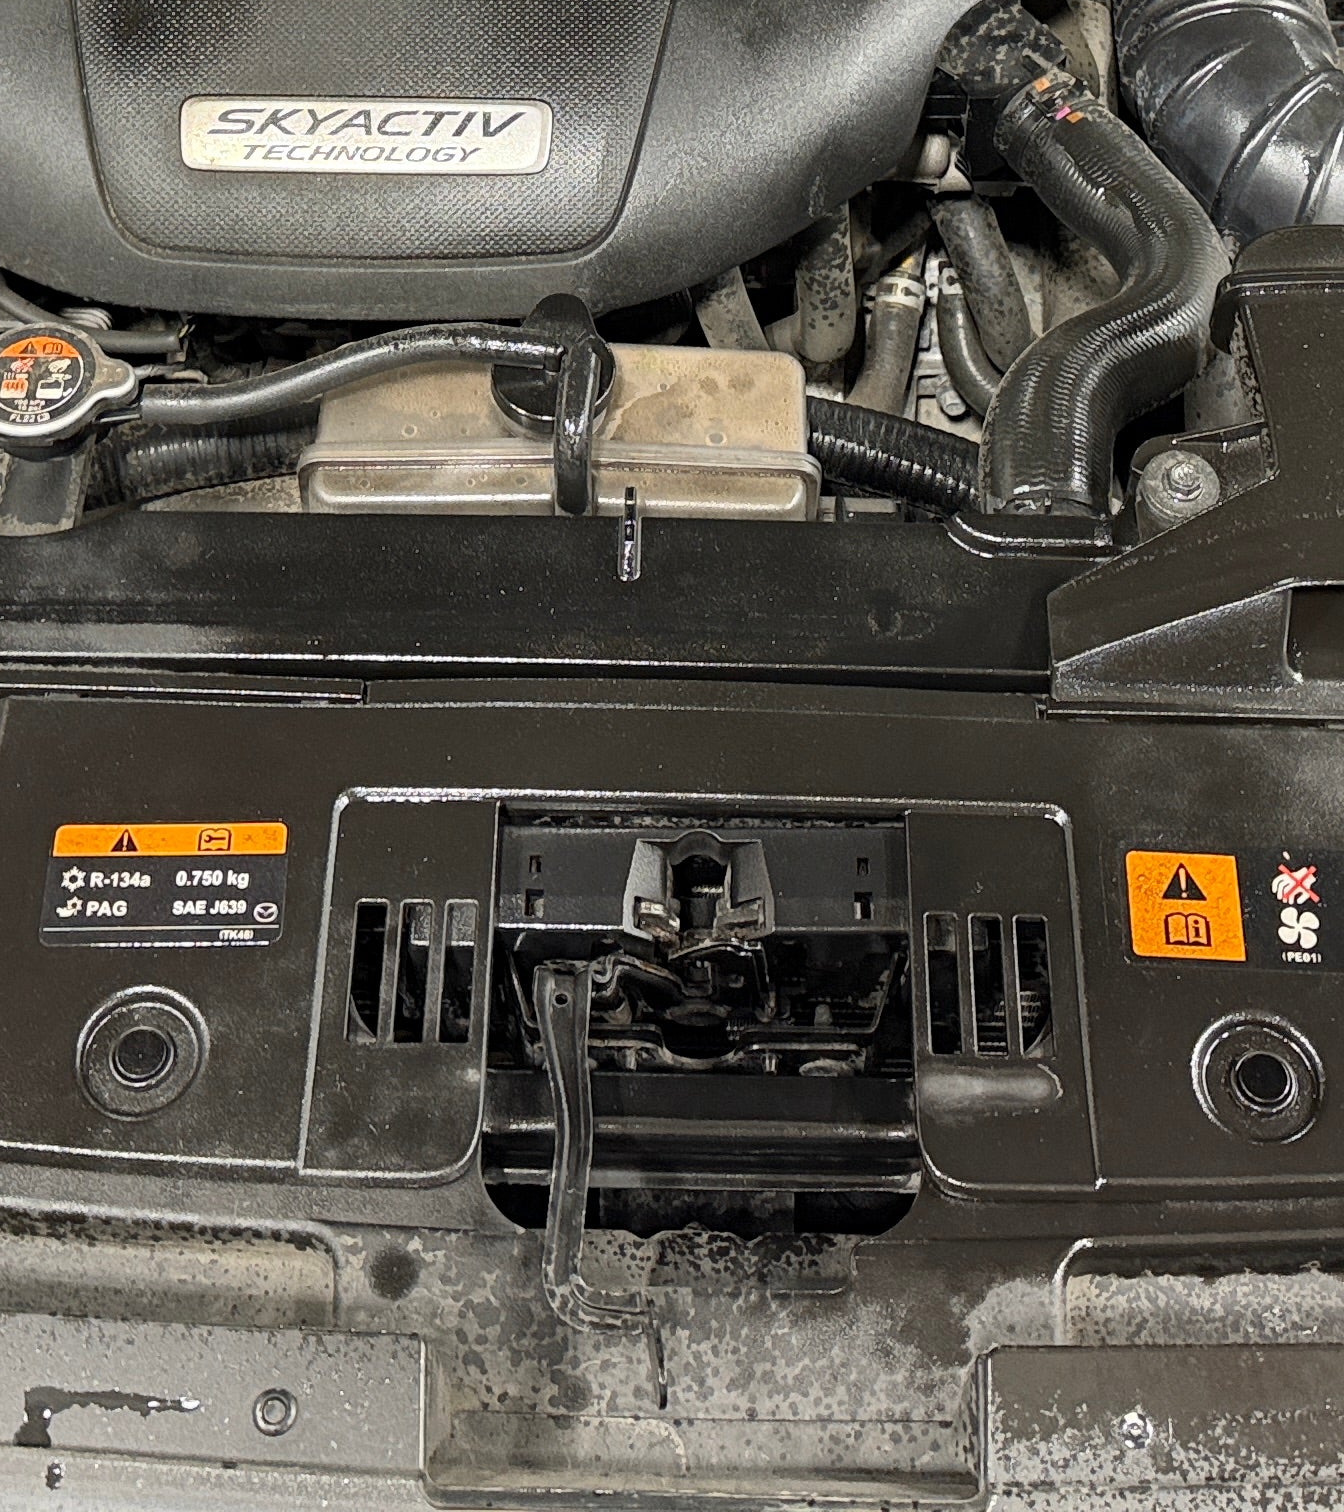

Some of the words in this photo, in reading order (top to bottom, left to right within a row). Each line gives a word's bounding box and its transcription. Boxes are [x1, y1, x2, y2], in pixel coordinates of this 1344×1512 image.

[207, 108, 528, 138] SKYACTIV
[242, 144, 483, 165] TECHNOLOGY
[9, 413, 35, 423] FL22
[90, 871, 151, 888] R-134a
[175, 870, 223, 887] 0.750
[227, 869, 250, 889] kg
[85, 901, 128, 917] PAG
[172, 900, 206, 915] SAE
[210, 899, 247, 915] J639
[1282, 951, 1322, 964] (PE01)
